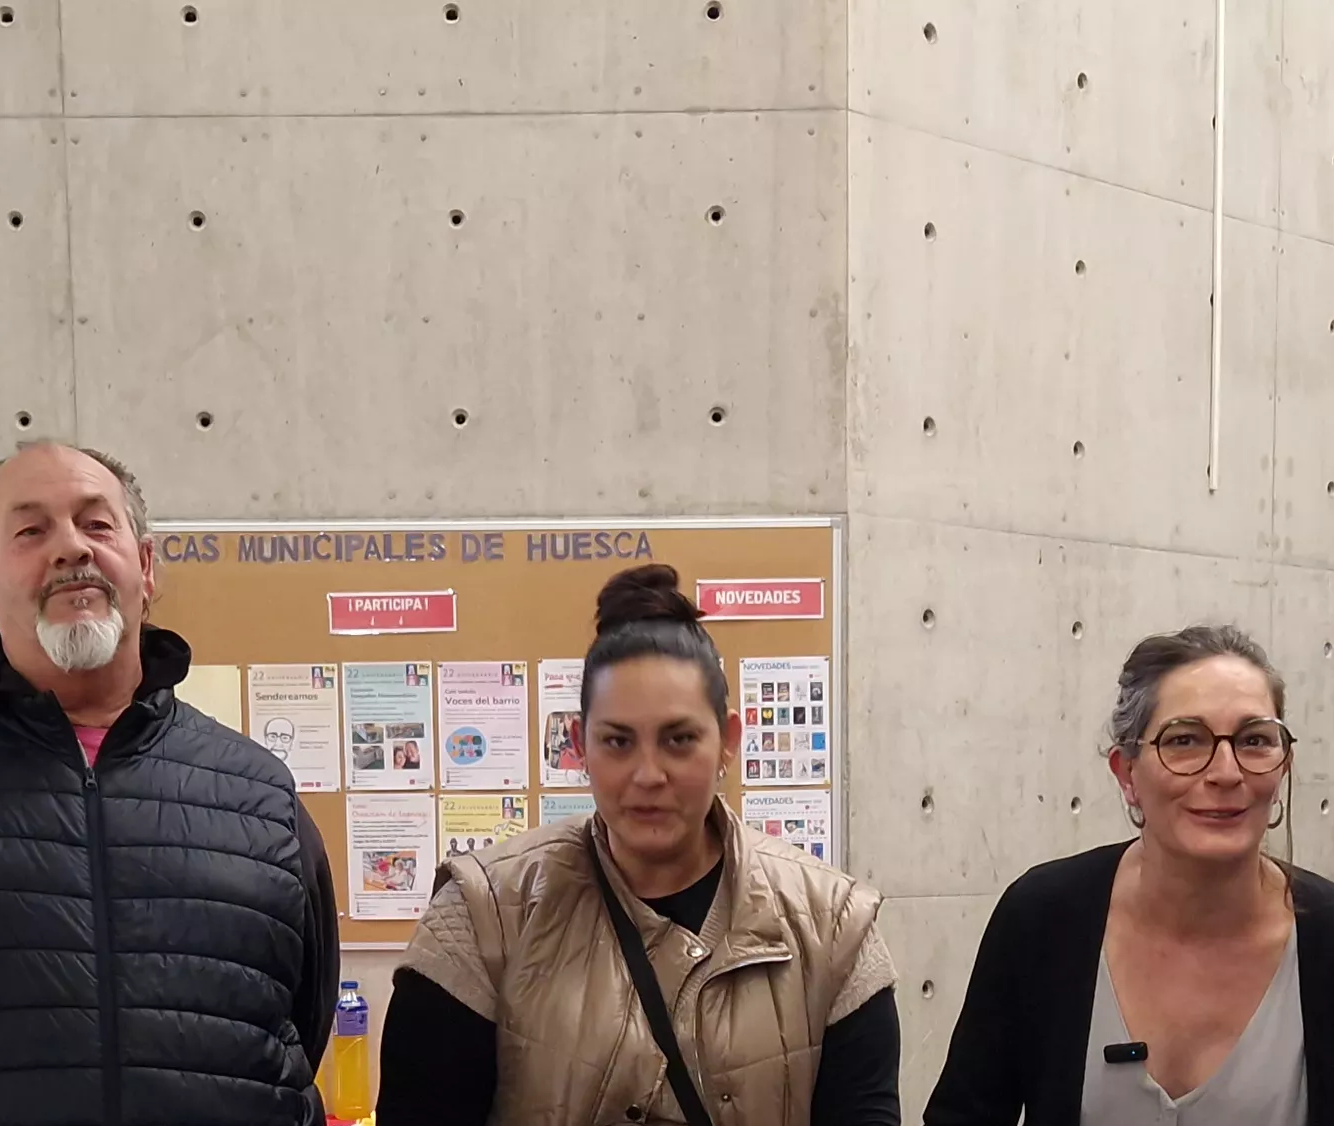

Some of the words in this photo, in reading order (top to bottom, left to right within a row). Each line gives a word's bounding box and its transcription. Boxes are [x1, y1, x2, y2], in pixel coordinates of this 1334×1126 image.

[162, 533, 220, 562] CAS
[237, 531, 446, 563] MUNICIPALES
[461, 532, 504, 562] DE
[526, 531, 653, 561] HUESCA
[715, 589, 801, 605] NOVEDADES
[743, 662, 791, 671] NOVEDADES
[252, 671, 265, 681] 22
[347, 669, 359, 679] 22
[443, 668, 455, 678] 22
[255, 692, 318, 701] Sendereamos
[445, 697, 473, 705] Voces
[475, 697, 490, 705] del
[492, 697, 520, 705] barrio
[443, 801, 456, 810] 22
[544, 800, 556, 809] 22
[746, 797, 793, 805] NOVEDADES
